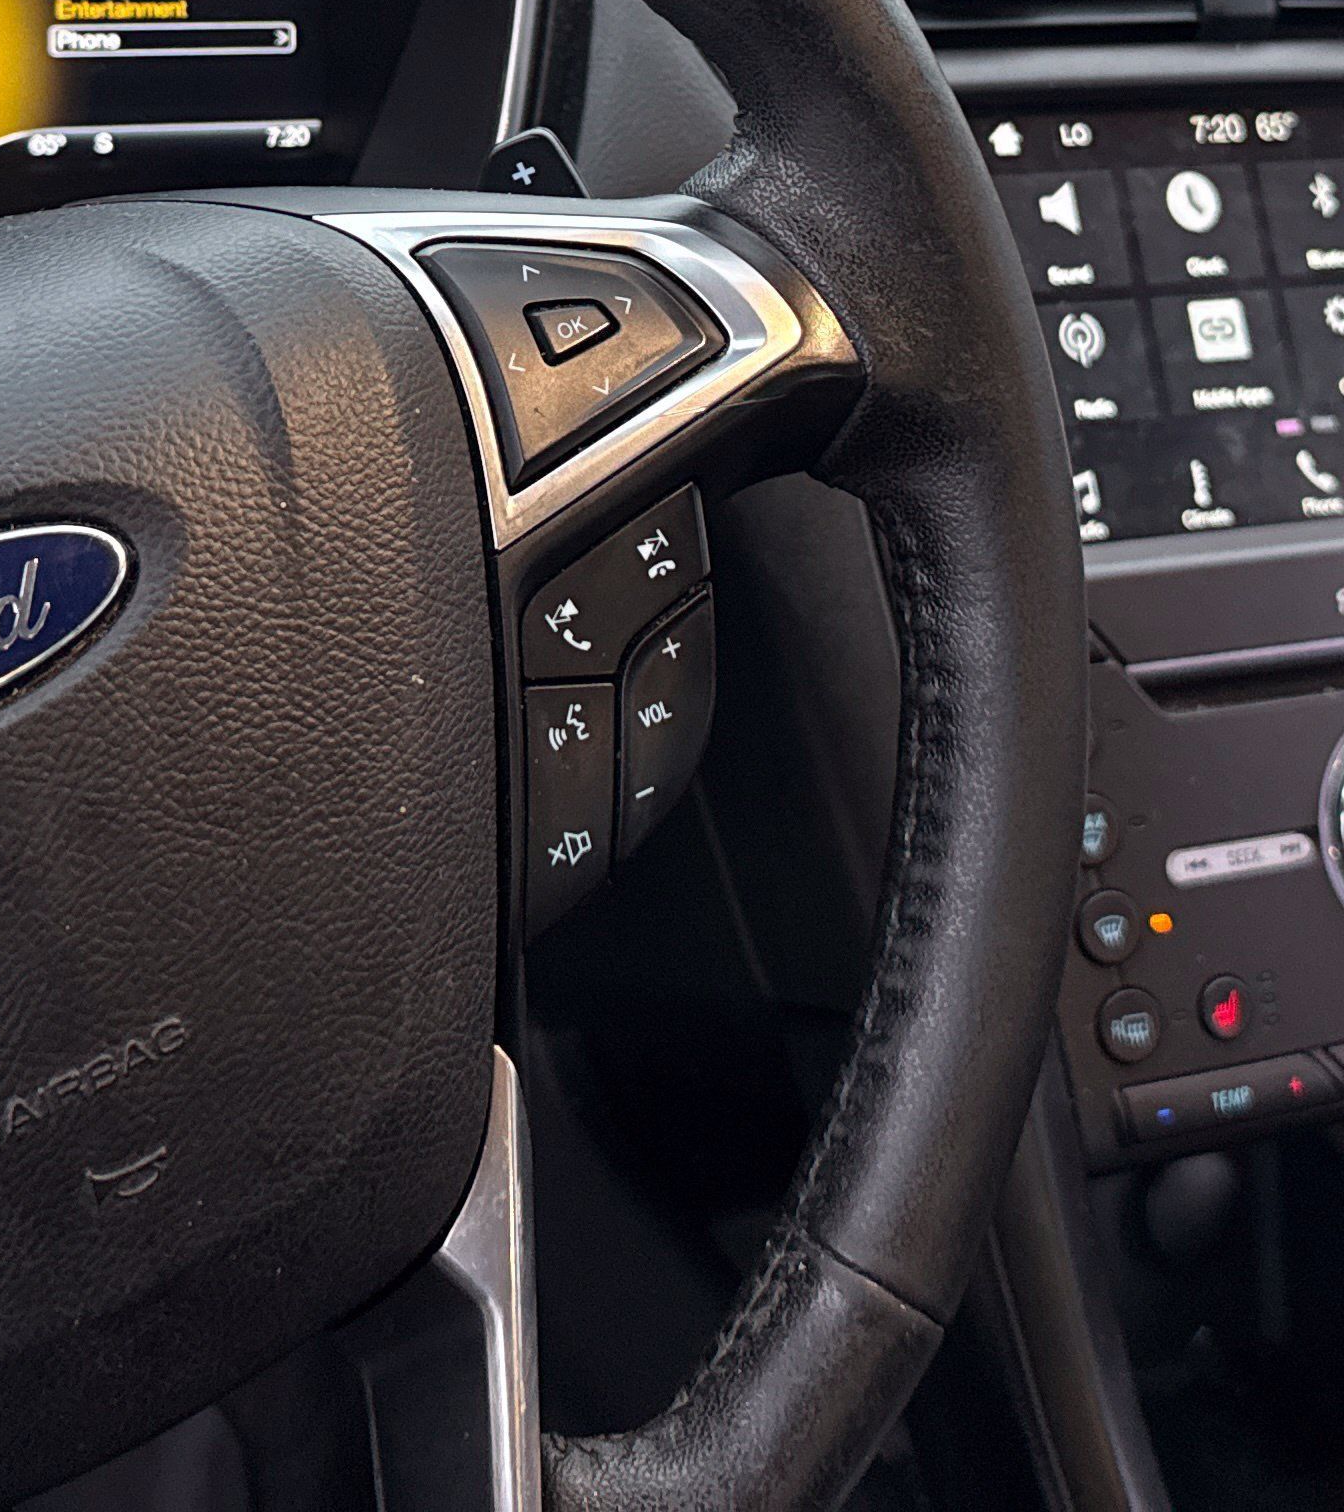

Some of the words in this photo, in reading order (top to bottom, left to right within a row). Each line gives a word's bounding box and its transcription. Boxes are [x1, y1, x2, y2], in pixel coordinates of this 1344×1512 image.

[56, 30, 122, 51] Phone
[1058, 122, 1094, 148] LO
[1189, 113, 1248, 145] 7:20
[557, 313, 589, 339] OK
[637, 701, 673, 728] VOL
[3, 1015, 189, 1136] AIRBAG
[1211, 1084, 1255, 1118] TEMP
